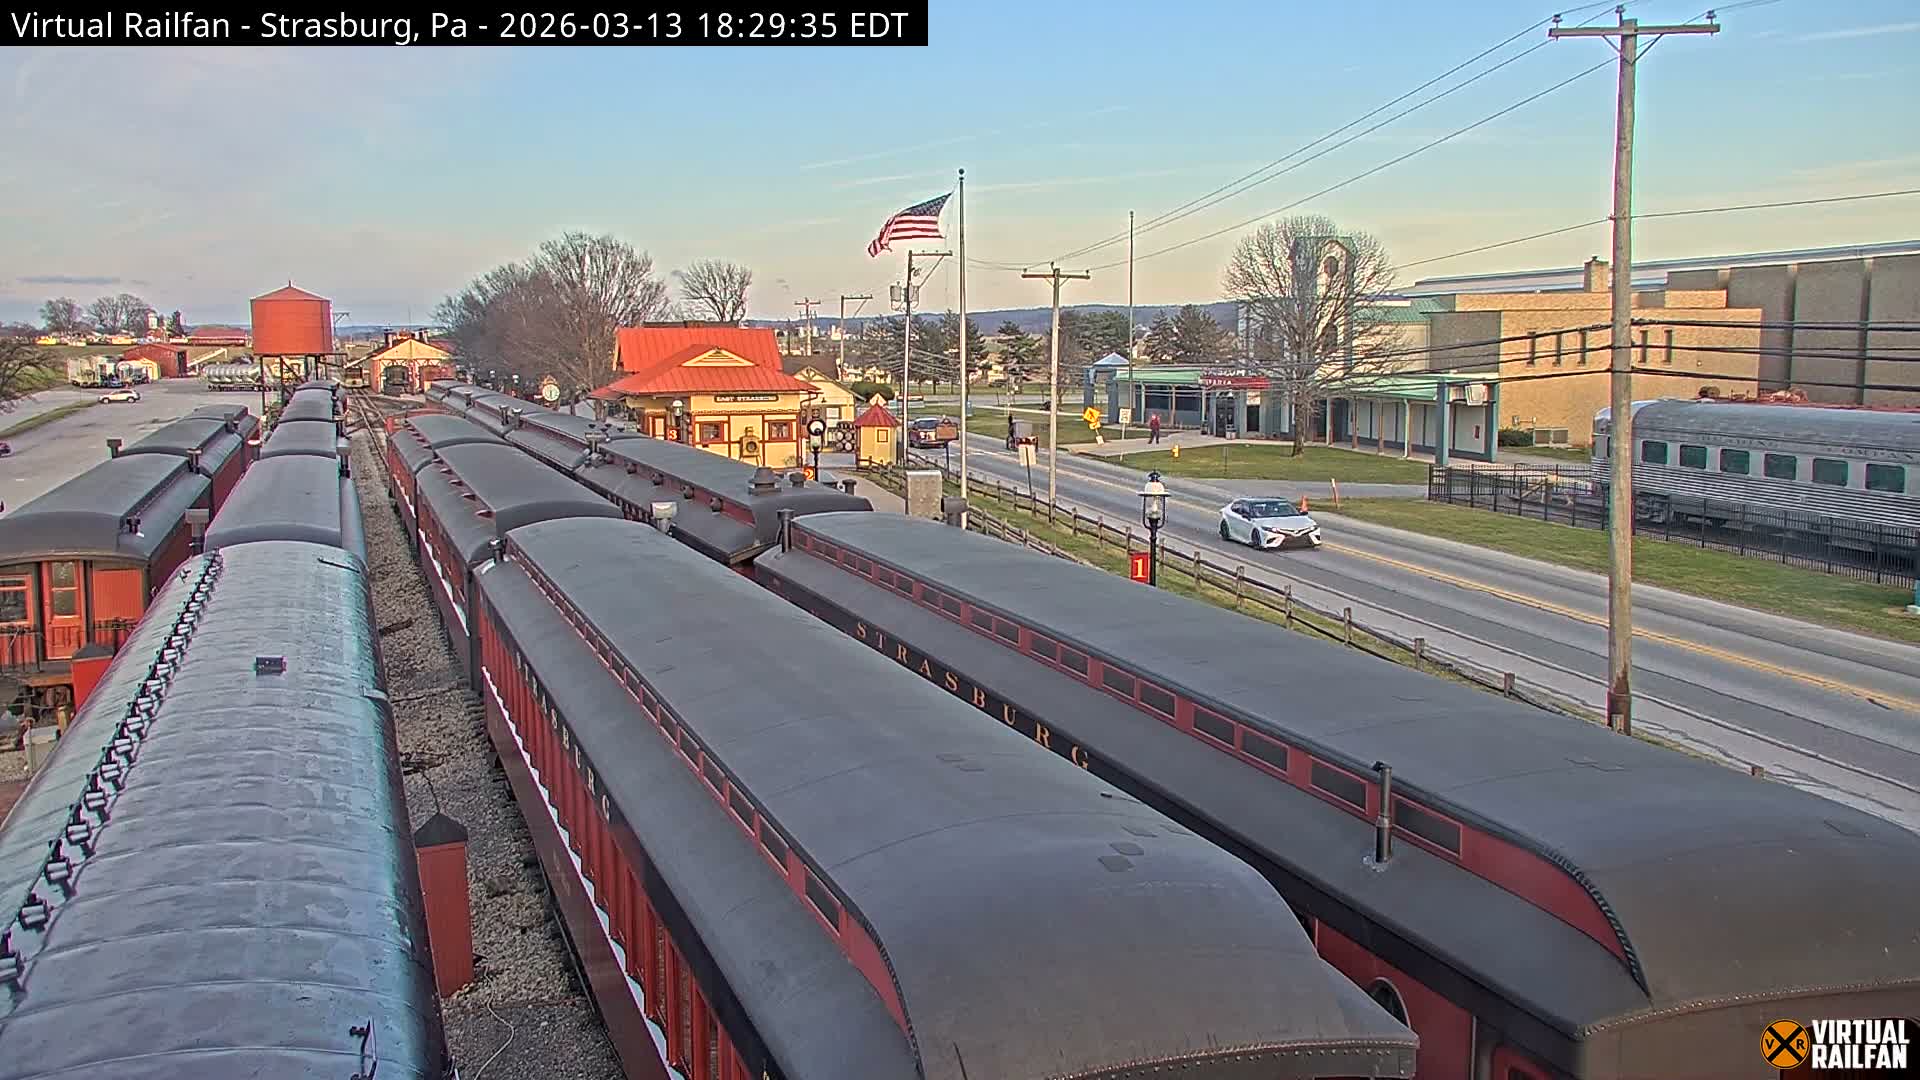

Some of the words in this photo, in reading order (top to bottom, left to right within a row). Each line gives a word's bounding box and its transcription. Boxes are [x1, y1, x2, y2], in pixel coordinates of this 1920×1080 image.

[669, 429, 678, 440] 3
[804, 469, 814, 481] 2
[1133, 558, 1147, 578] 1
[856, 621, 1089, 771] STRASBURG
[516, 651, 611, 824] STRASBURG
